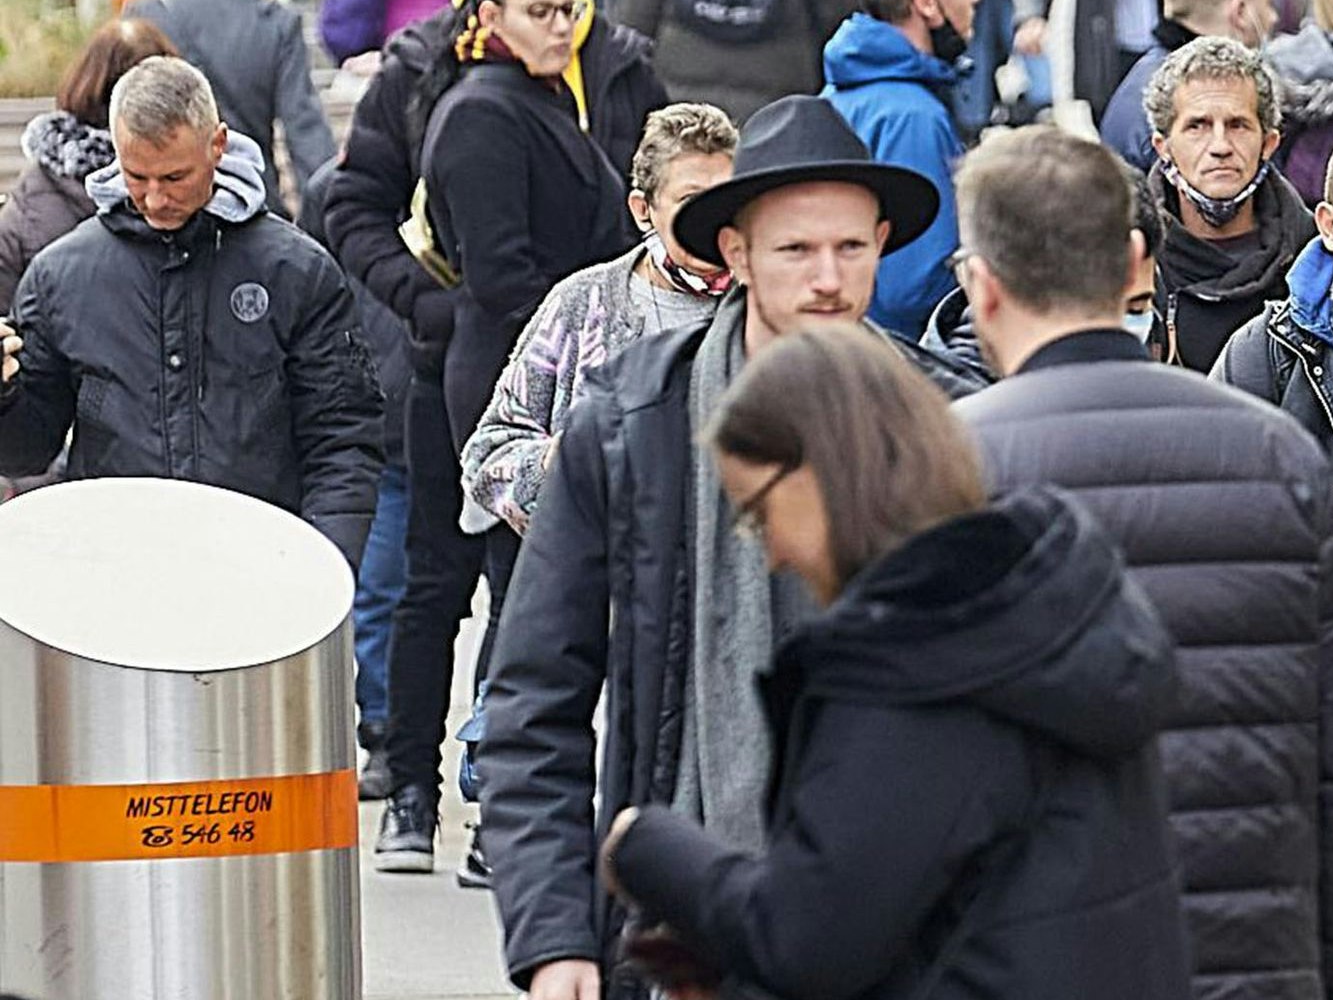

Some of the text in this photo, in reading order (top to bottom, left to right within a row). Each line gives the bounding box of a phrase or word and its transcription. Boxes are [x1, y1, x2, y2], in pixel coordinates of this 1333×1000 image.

[126, 791, 273, 818] MISTTELEFON
[181, 821, 255, 845] 546 48
